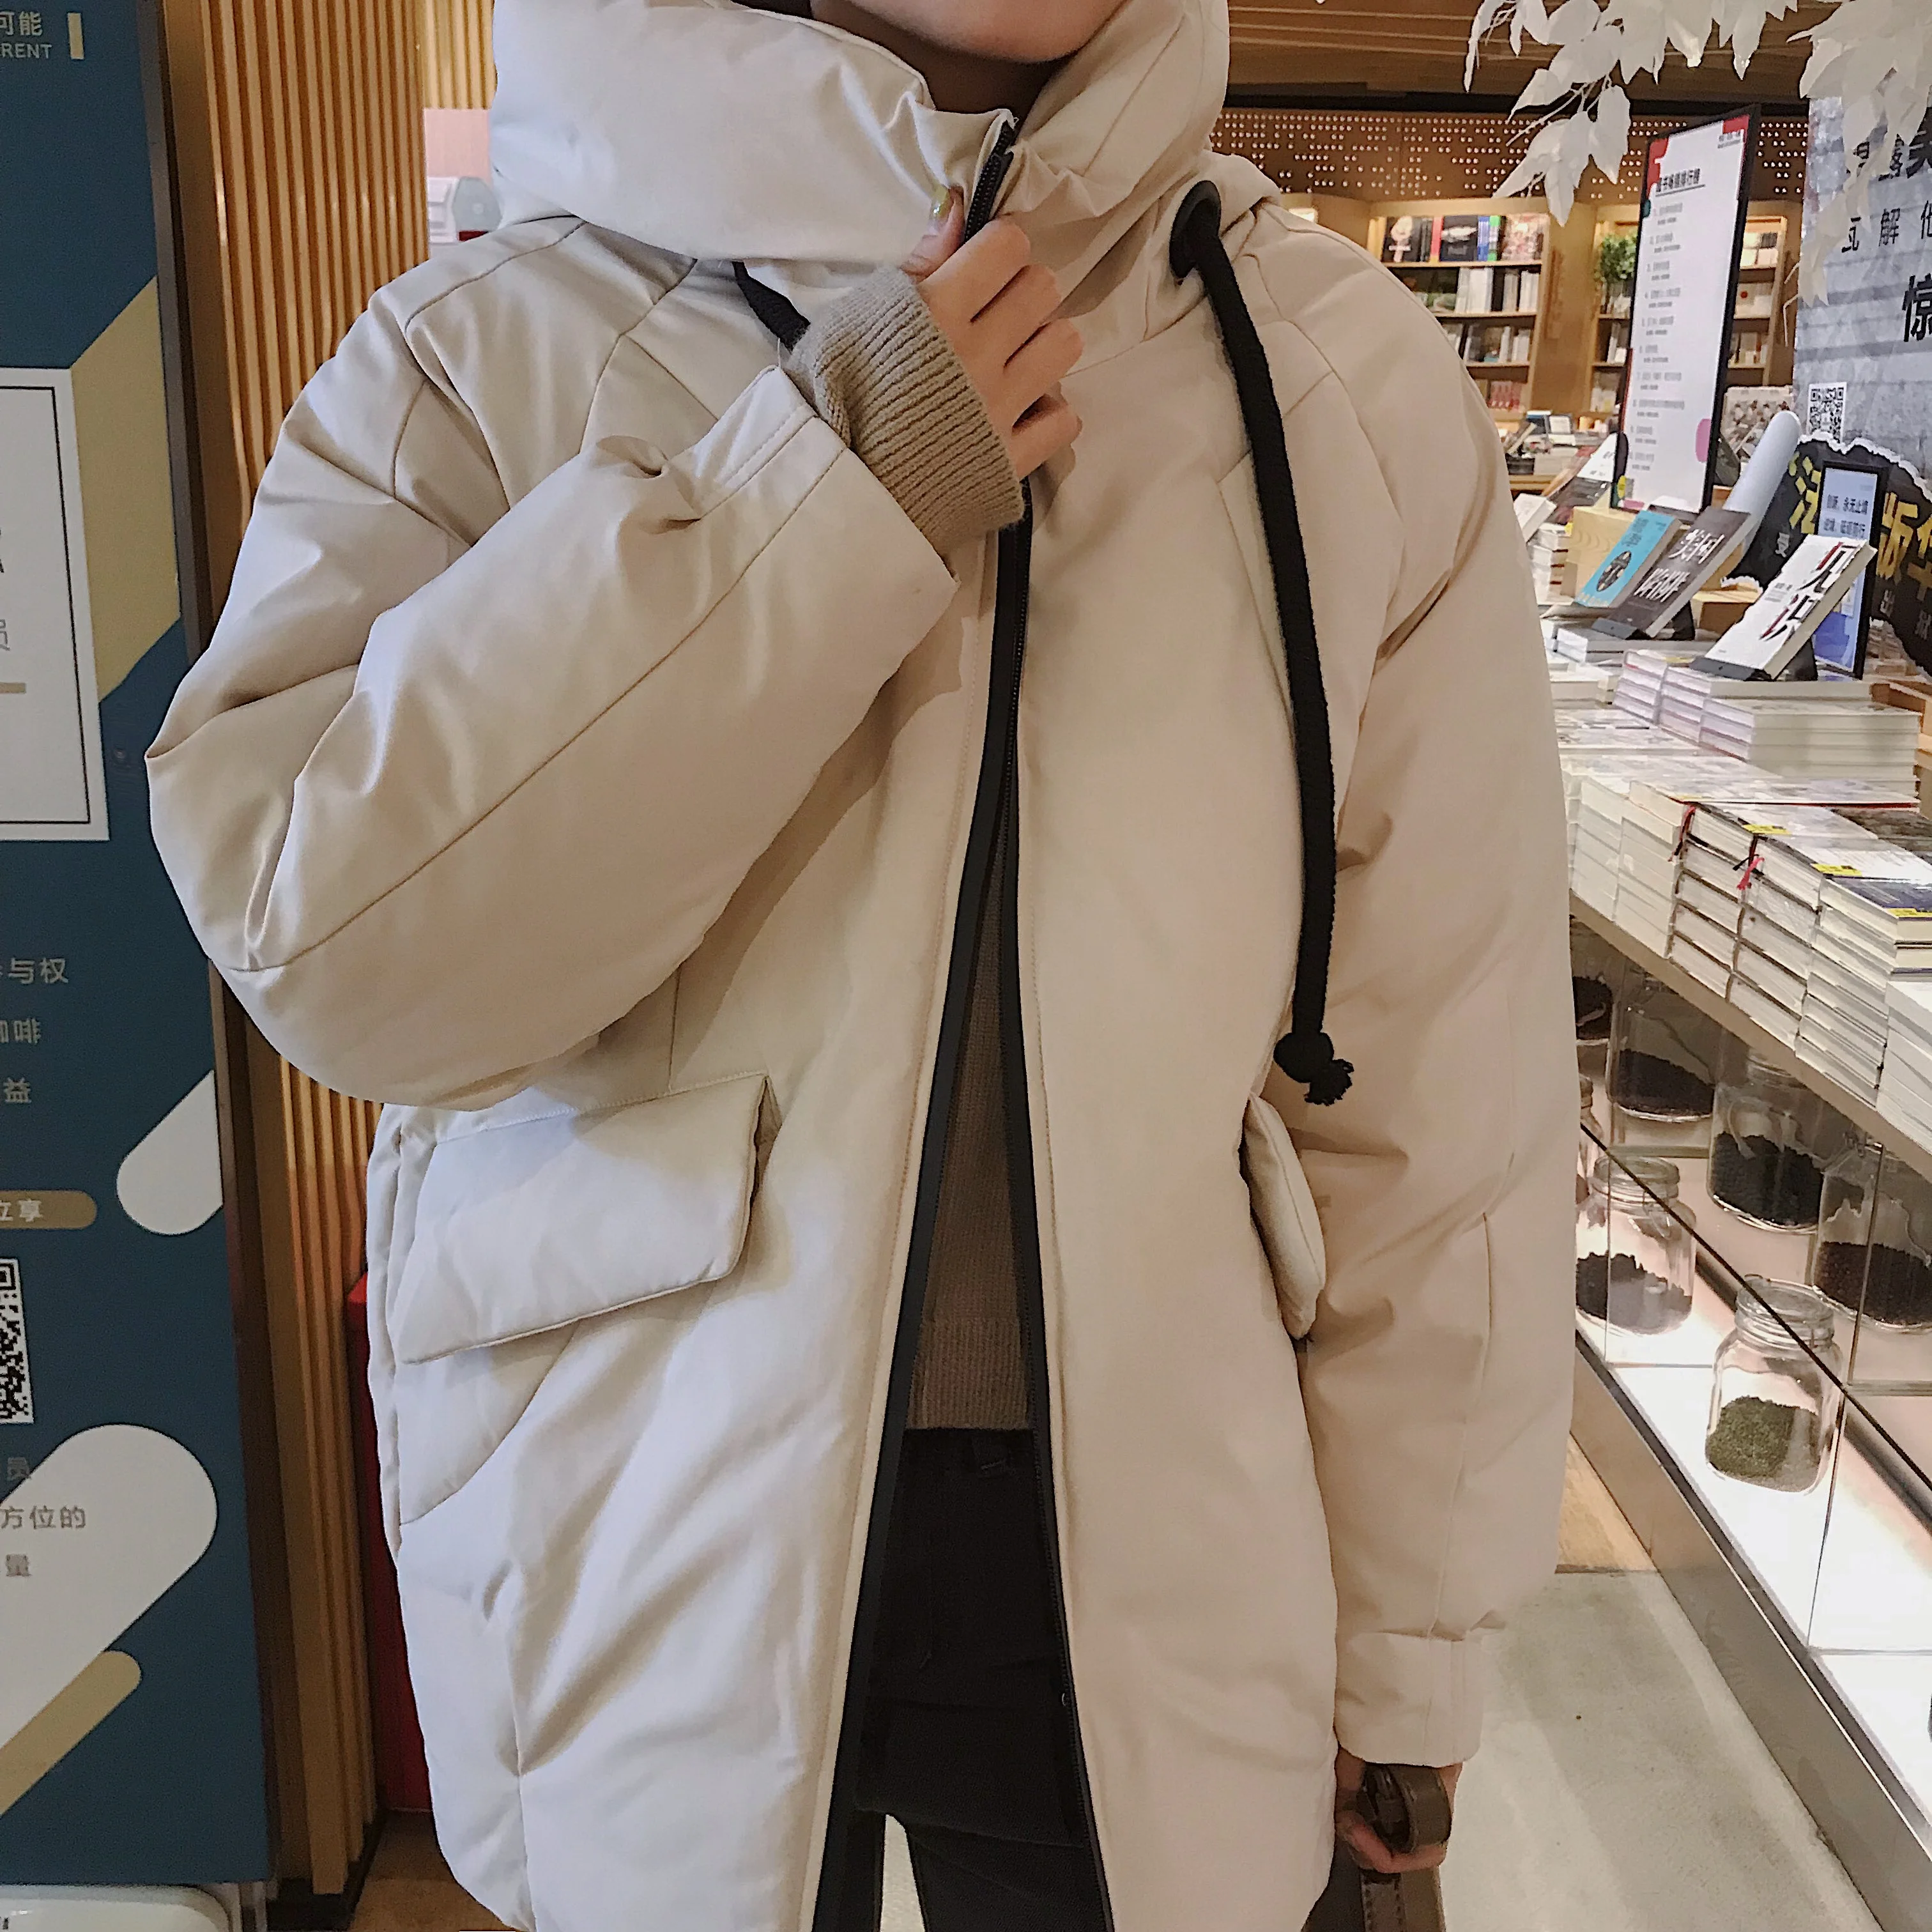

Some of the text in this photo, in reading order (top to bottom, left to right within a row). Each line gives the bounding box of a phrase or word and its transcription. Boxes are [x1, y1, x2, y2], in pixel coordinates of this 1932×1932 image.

[0, 957, 69, 984] 与权
[3, 1077, 32, 1103] 益
[0, 1505, 86, 1529] 方位的
